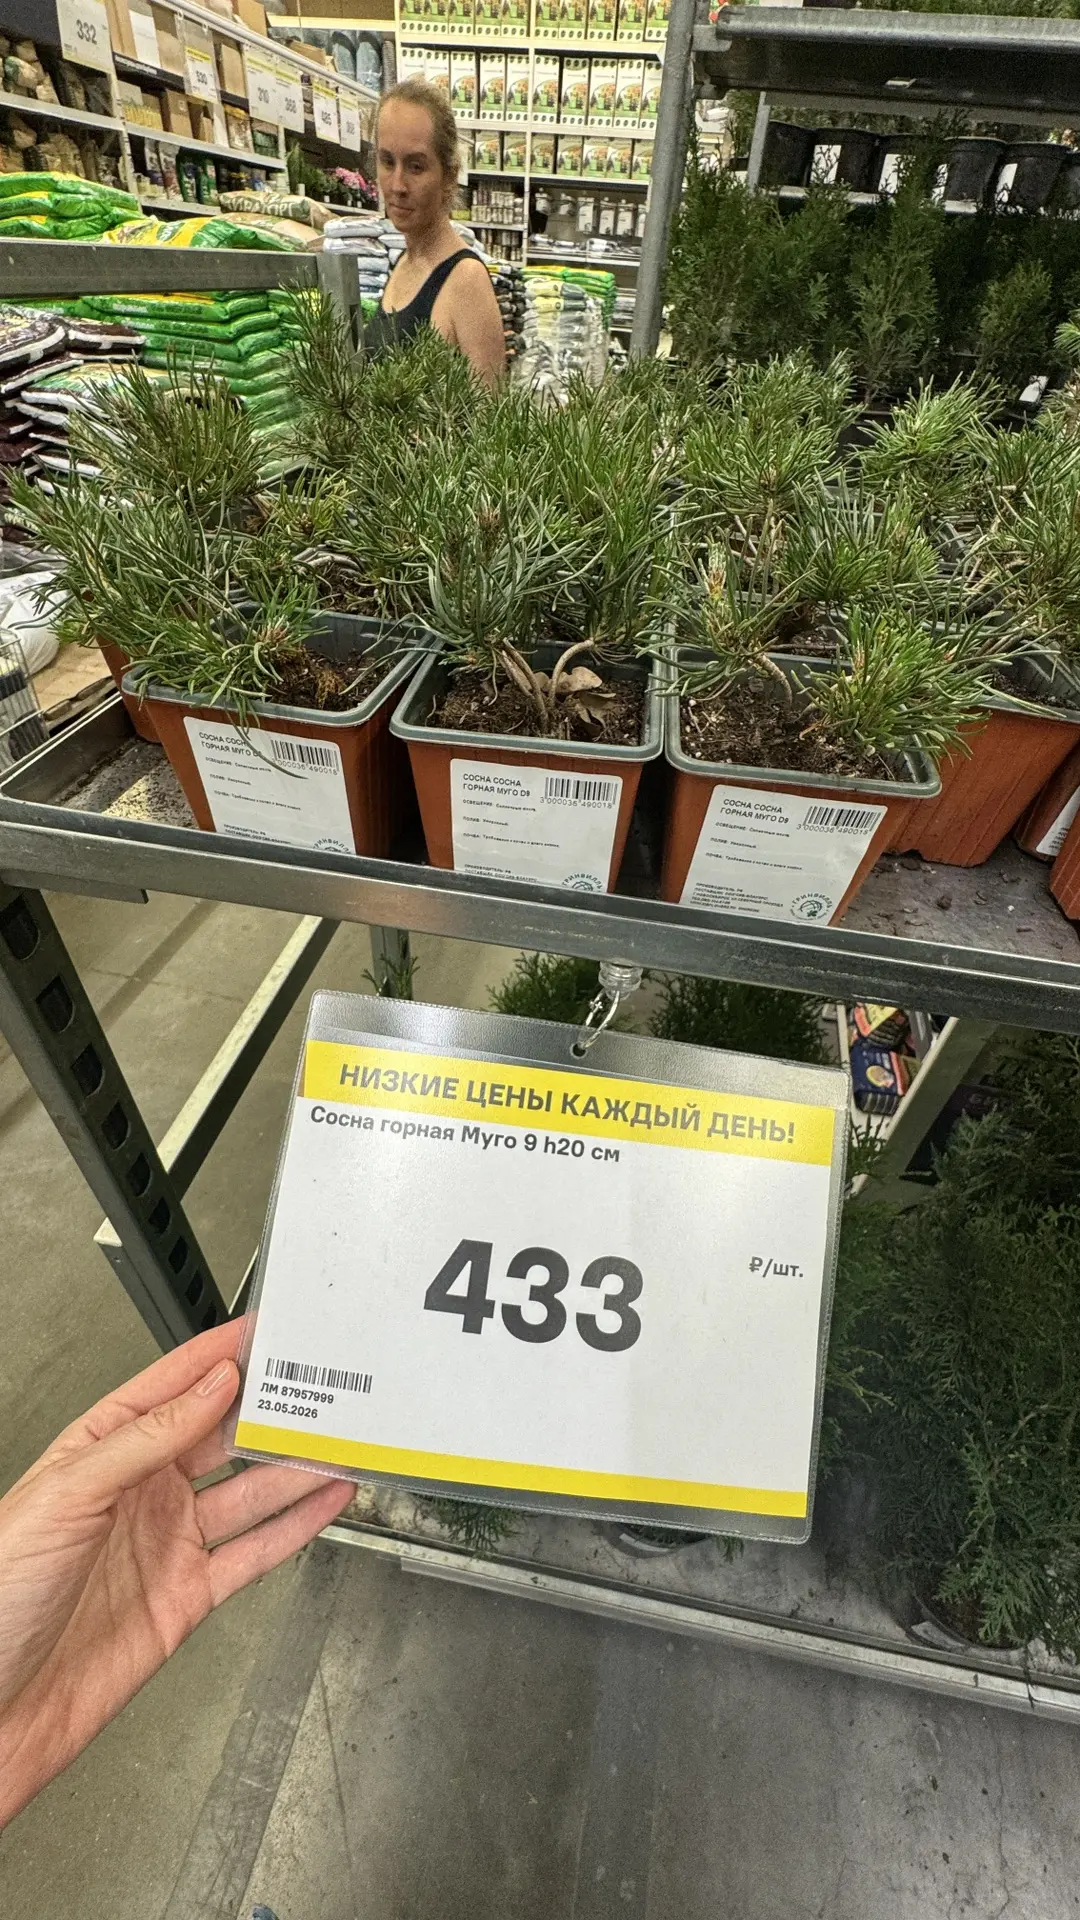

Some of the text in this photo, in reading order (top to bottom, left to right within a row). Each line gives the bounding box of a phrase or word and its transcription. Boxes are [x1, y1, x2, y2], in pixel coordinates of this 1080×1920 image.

[75, 19, 98, 45] 332
[199, 732, 225, 742] СОСНА
[201, 741, 230, 752] ГОРНАЯ
[231, 747, 251, 756] МУГО
[463, 773, 522, 787] СОСНА СОСНА
[463, 783, 531, 798] ГОРНАЯ МУГО D9
[720, 807, 789, 824] ГОРНАЯ МУГО D9
[723, 798, 782, 814] СОСНА СОСНА
[339, 1063, 795, 1144] НИЗКИЕ ЦЕНЫ КАЖДЫЙ ДЕНЬ!
[310, 1105, 621, 1162] Сосна горная Муго 9 h20 см
[748, 1255, 804, 1279] ₽/шт.
[423, 1238, 644, 1353] 433
[260, 1382, 335, 1404] ЛМ 87957999
[257, 1399, 319, 1419] 23.05.2026
